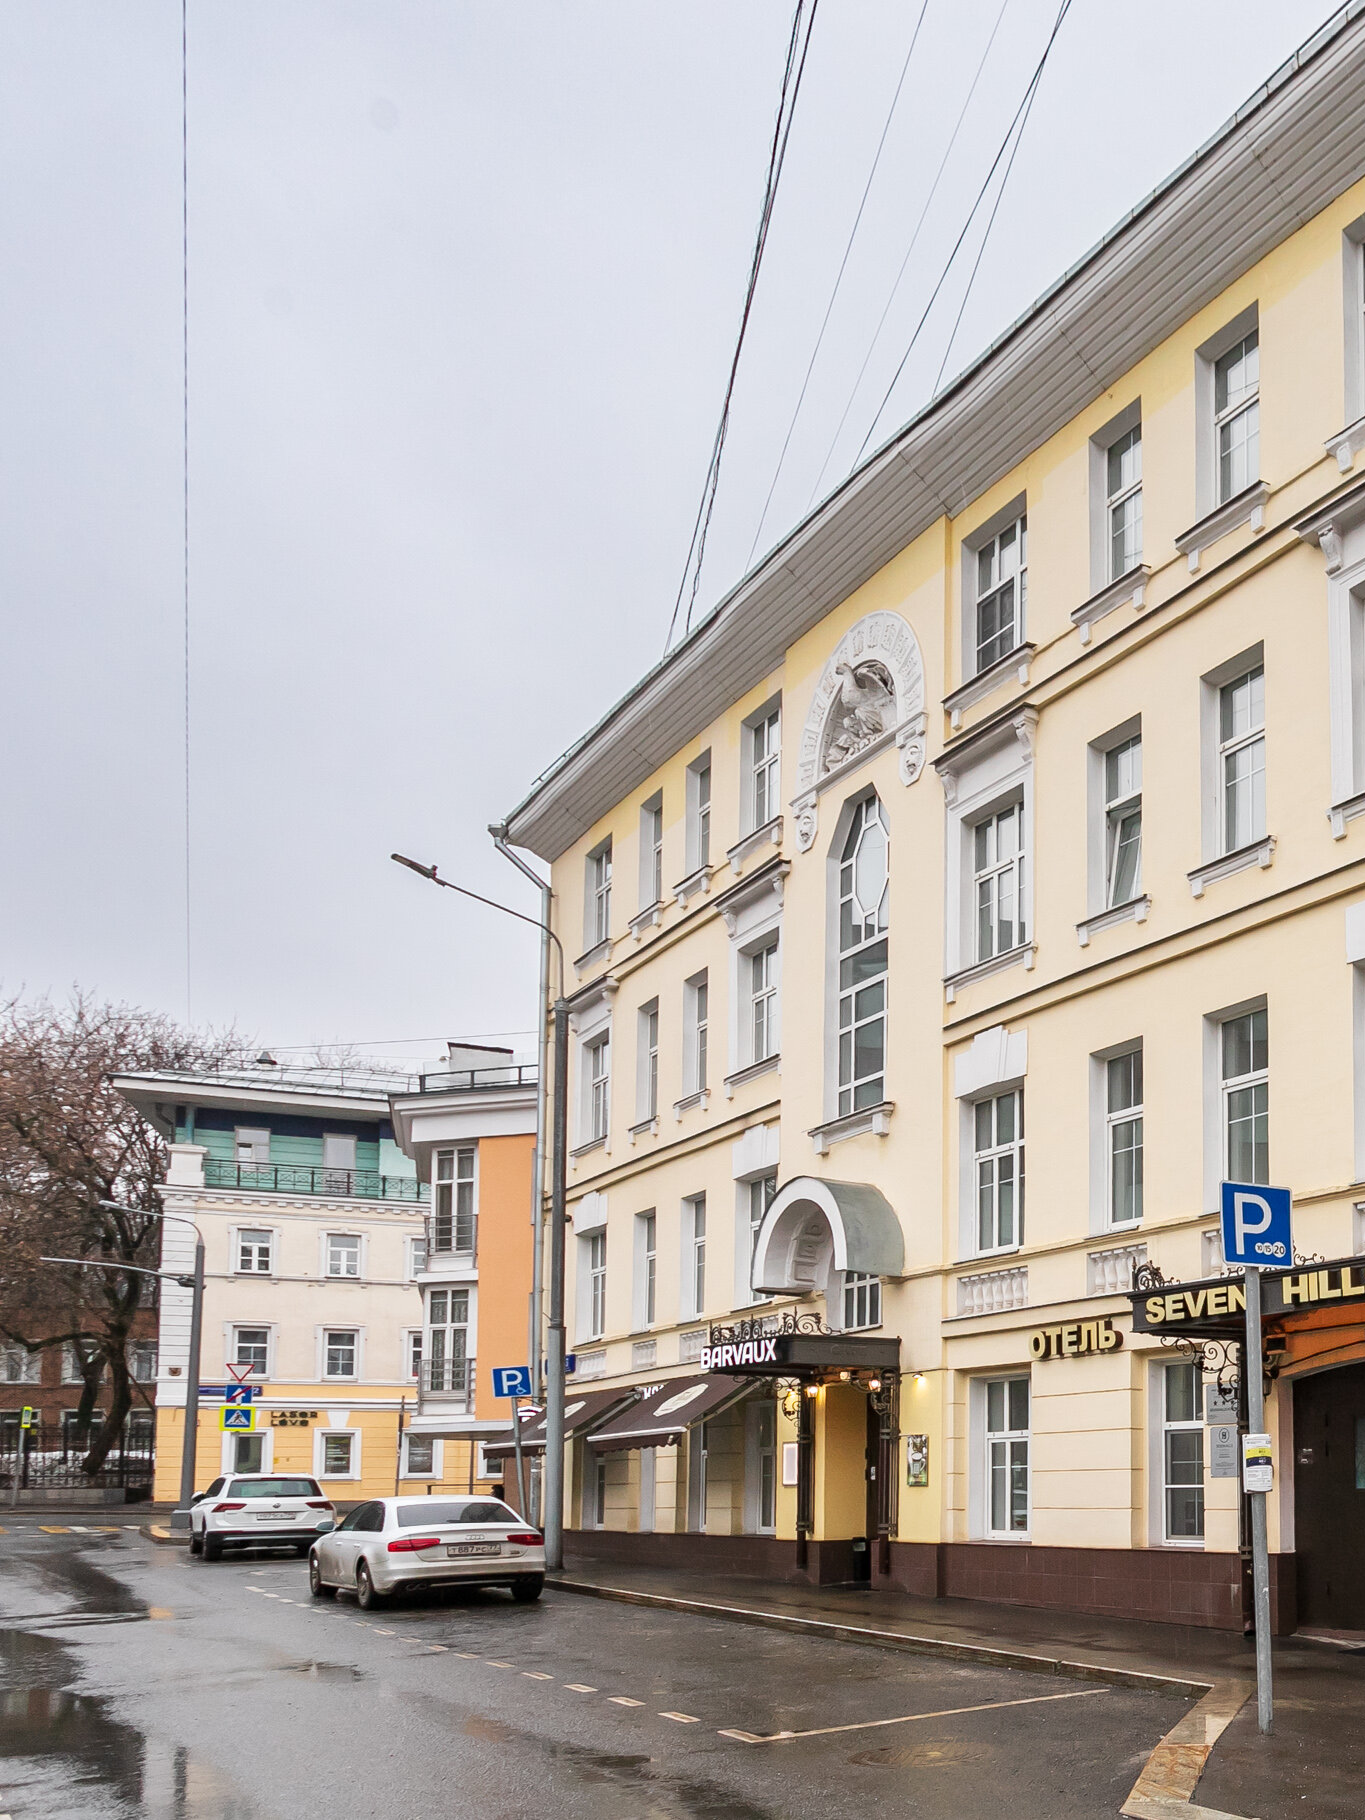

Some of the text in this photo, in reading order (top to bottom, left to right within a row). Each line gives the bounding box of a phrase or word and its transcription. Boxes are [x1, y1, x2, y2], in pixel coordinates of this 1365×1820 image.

[1234, 1192, 1272, 1255] P
[1274, 1245, 1285, 1255] 20
[1145, 1284, 1246, 1324] SEVEN
[700, 1338, 777, 1370] BARVAUX
[1029, 1320, 1117, 1359] ОТЕЛЬ
[501, 1370, 523, 1394] P
